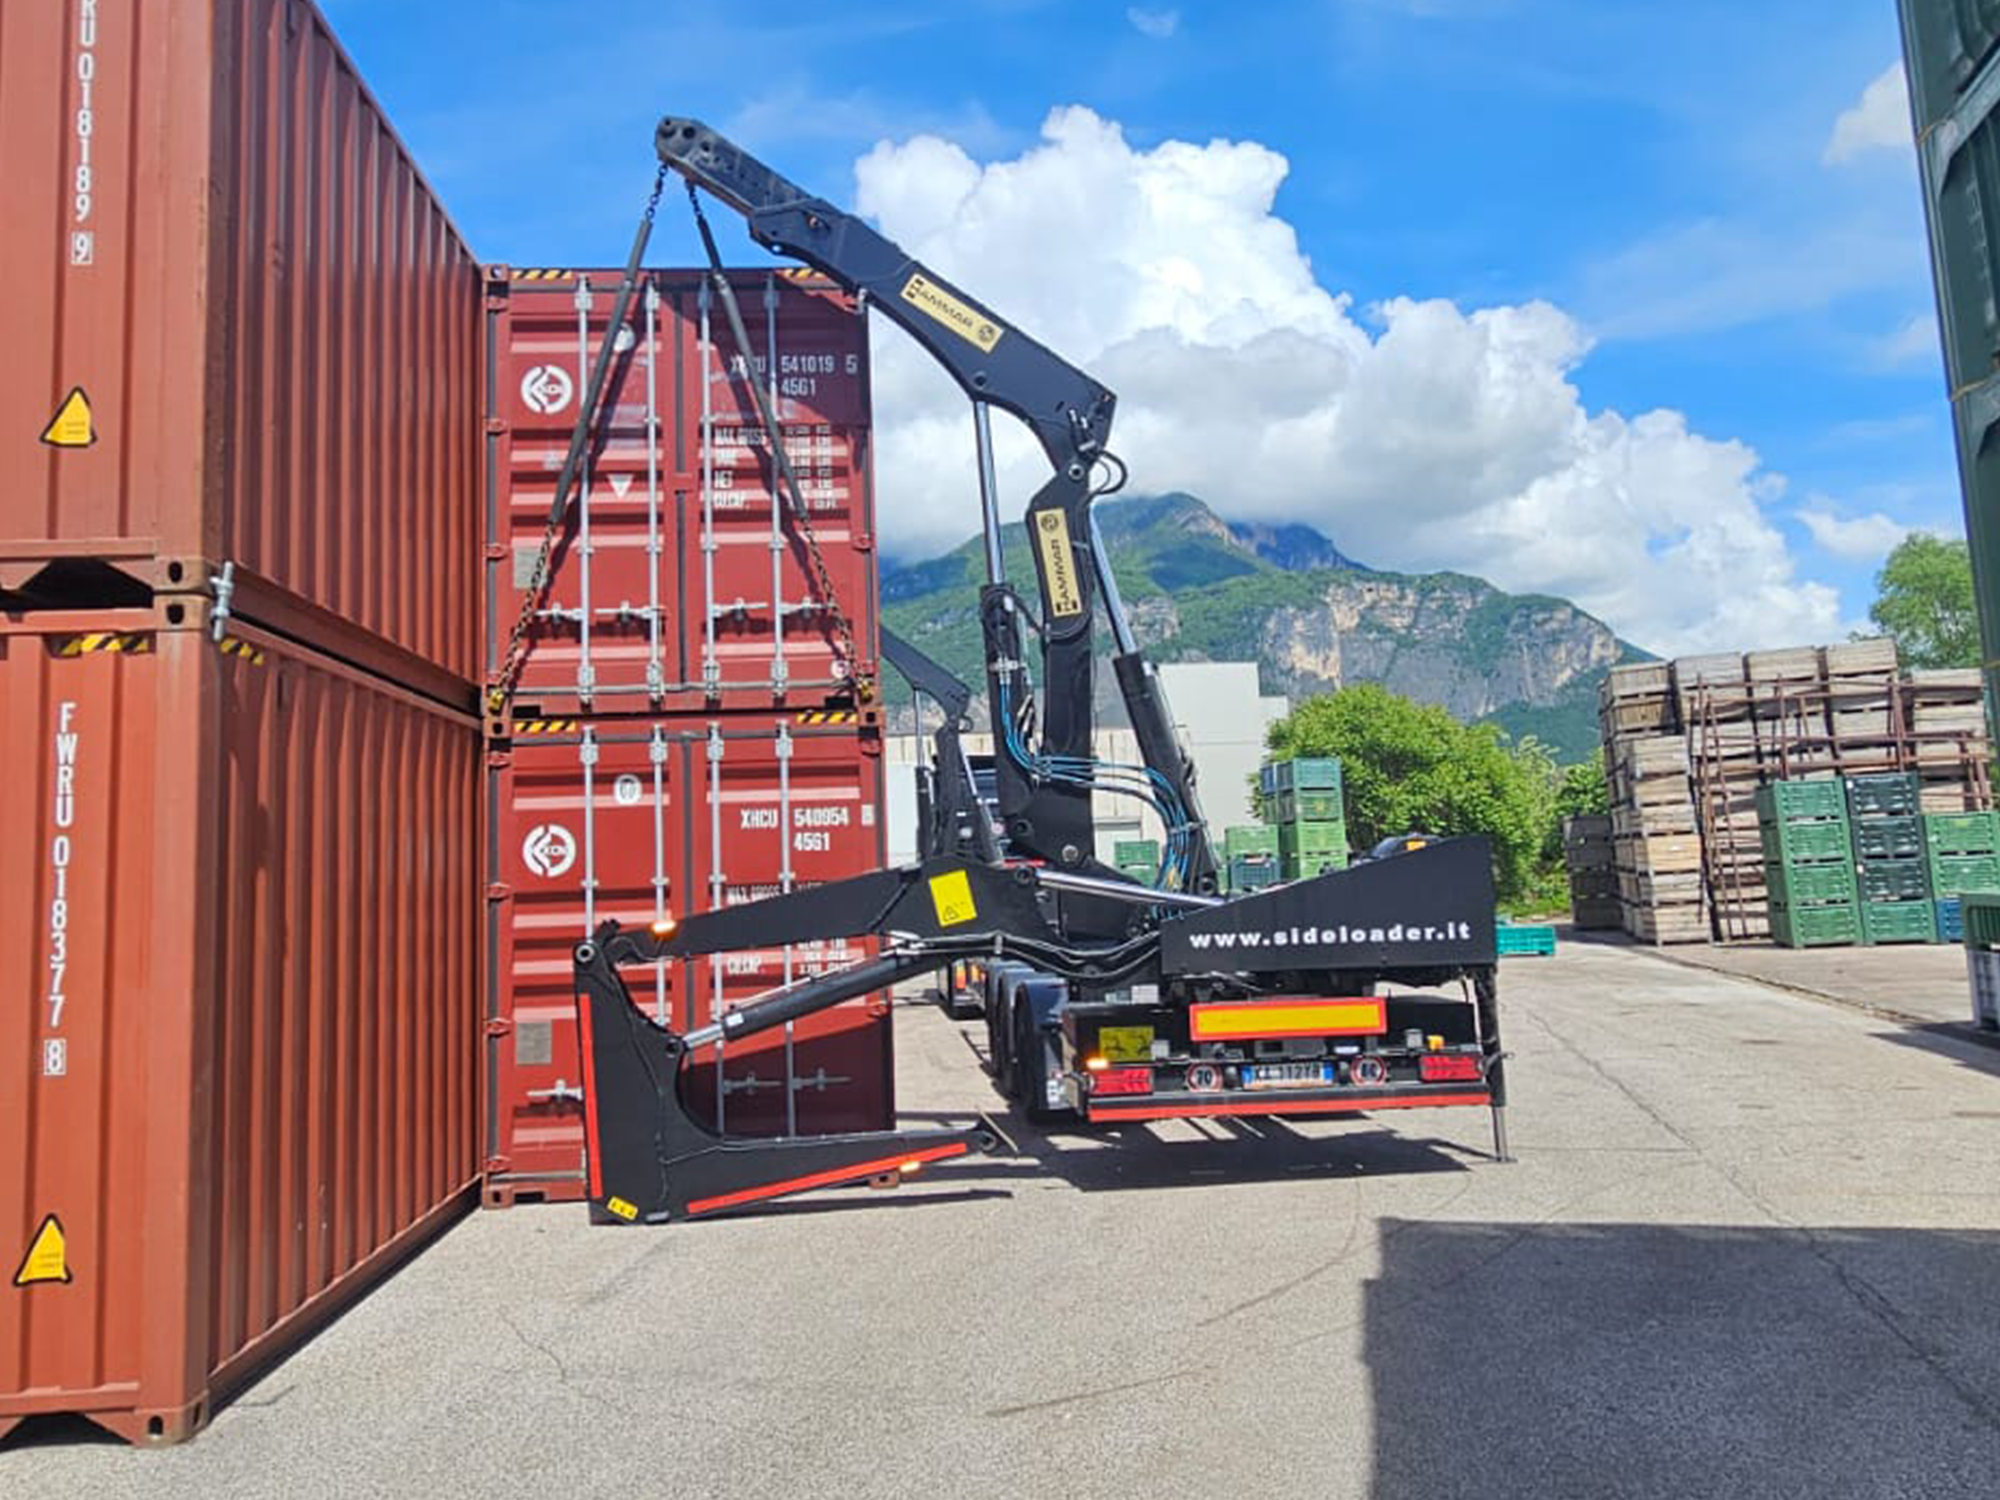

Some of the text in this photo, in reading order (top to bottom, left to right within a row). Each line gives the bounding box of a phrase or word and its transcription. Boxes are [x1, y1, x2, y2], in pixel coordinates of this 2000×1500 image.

[76, 52, 95, 223] 018189
[73, 232, 92, 264] 9
[781, 354, 835, 374] 541019
[846, 352, 859, 375] 5
[1050, 538, 1078, 614] HAMMAR
[740, 808, 778, 830] XHCU
[46, 702, 79, 1074] FWRU 018377 8
[1189, 922, 1471, 948] www.sideloader.it
